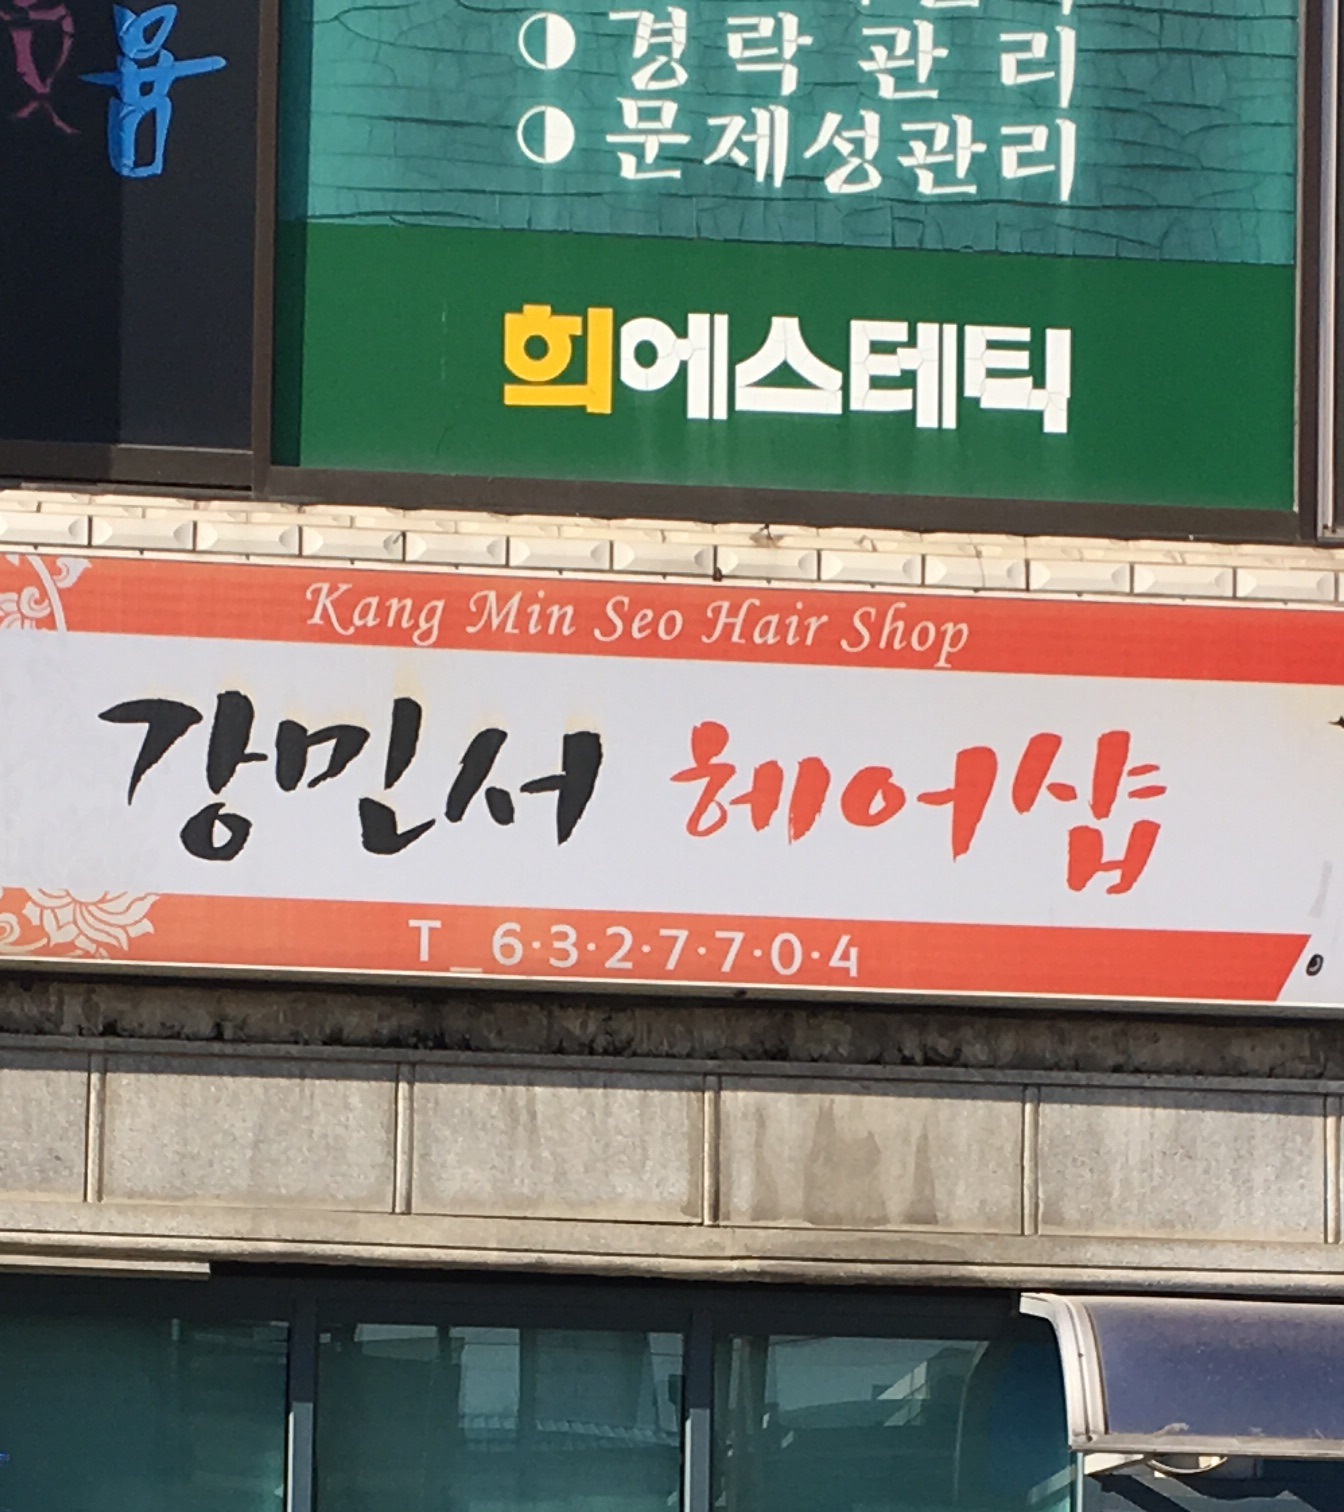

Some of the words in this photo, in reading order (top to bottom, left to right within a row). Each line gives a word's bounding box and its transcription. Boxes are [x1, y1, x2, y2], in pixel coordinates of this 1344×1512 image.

[606, 96, 1077, 202] 문제성관리
[503, 304, 1072, 433] 희에스테틱
[305, 581, 441, 646] Kang
[465, 590, 577, 636] Min
[594, 594, 684, 643] Seo
[701, 602, 828, 648] Hair
[841, 606, 969, 671] Shop
[97, 690, 603, 862] 강민서
[669, 719, 1168, 896] 헤어샵
